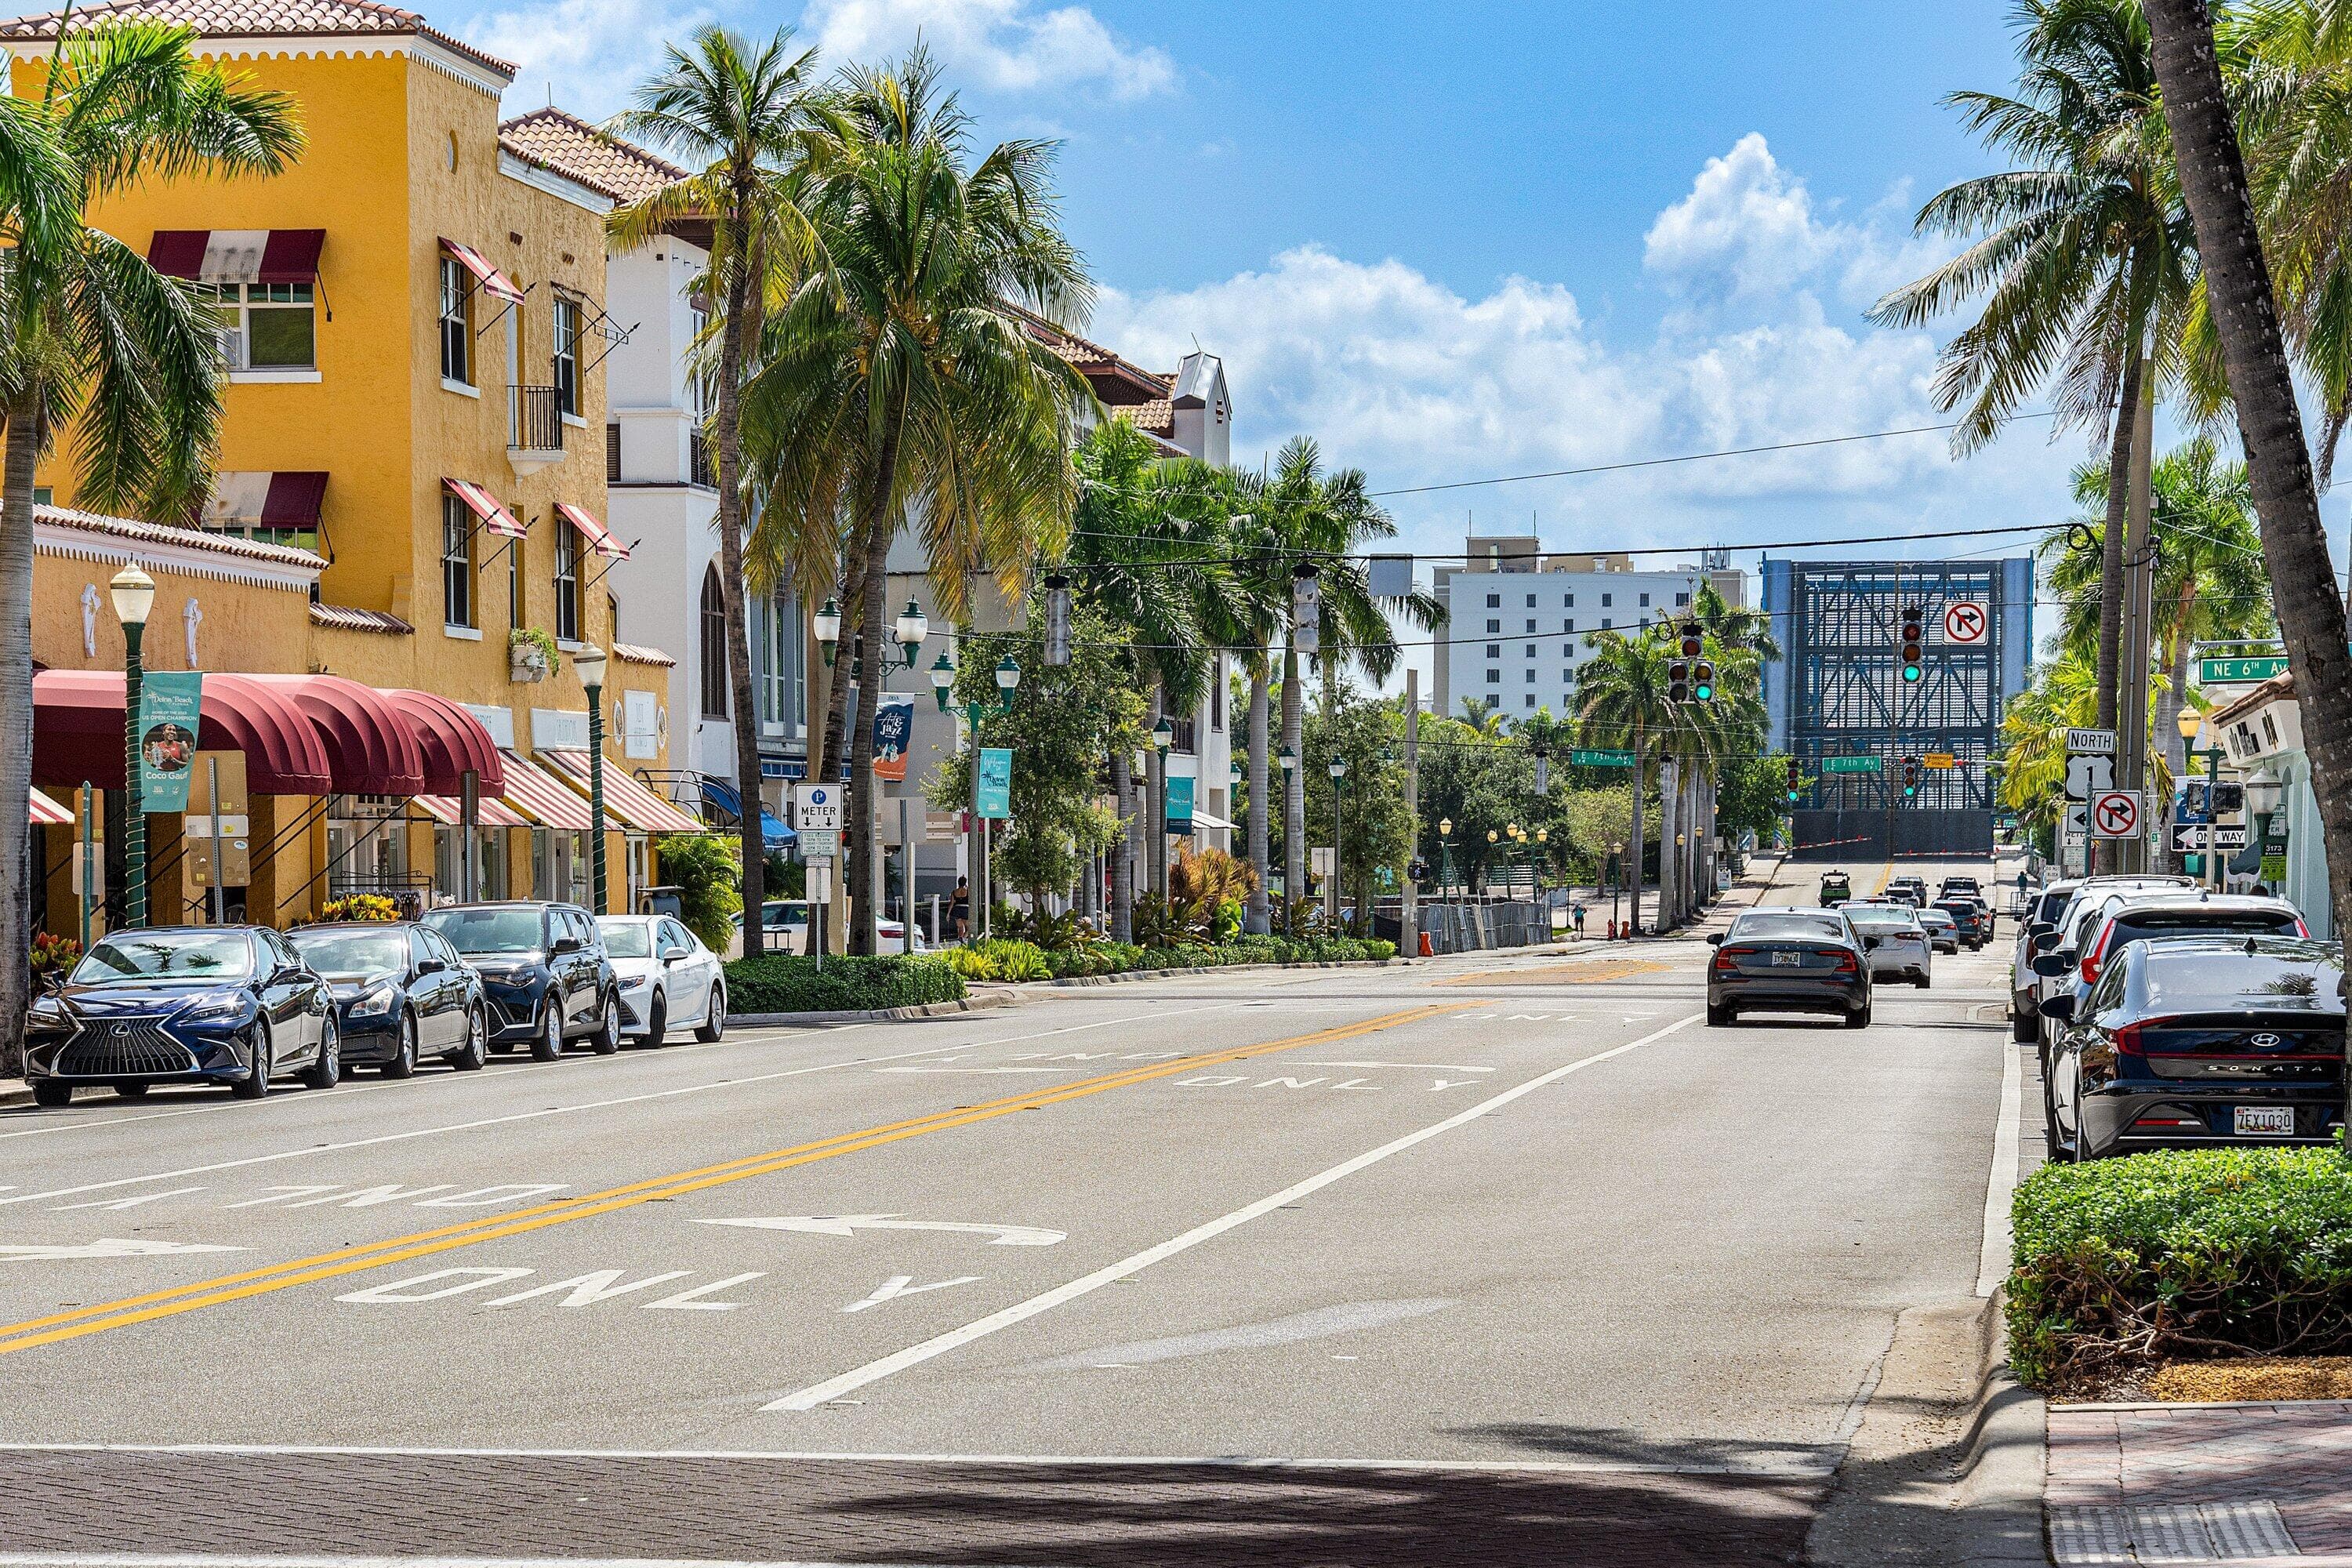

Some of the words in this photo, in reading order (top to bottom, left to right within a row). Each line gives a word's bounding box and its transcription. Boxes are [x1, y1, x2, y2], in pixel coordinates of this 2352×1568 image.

[2213, 662, 2231, 677] NE
[2242, 661, 2259, 676] 6TH
[172, 695, 194, 704] Beach
[2071, 732, 2111, 748] NORTH
[1831, 759, 1836, 768] E
[2086, 765, 2093, 783] 1
[801, 807, 837, 815] METER
[2222, 832, 2244, 842] WAY
[1450, 1013, 1653, 1022] ONLY
[1172, 1076, 1483, 1091] ONLY
[2238, 1113, 2291, 1130] 7EX1030
[332, 1266, 985, 1314] ONLY
